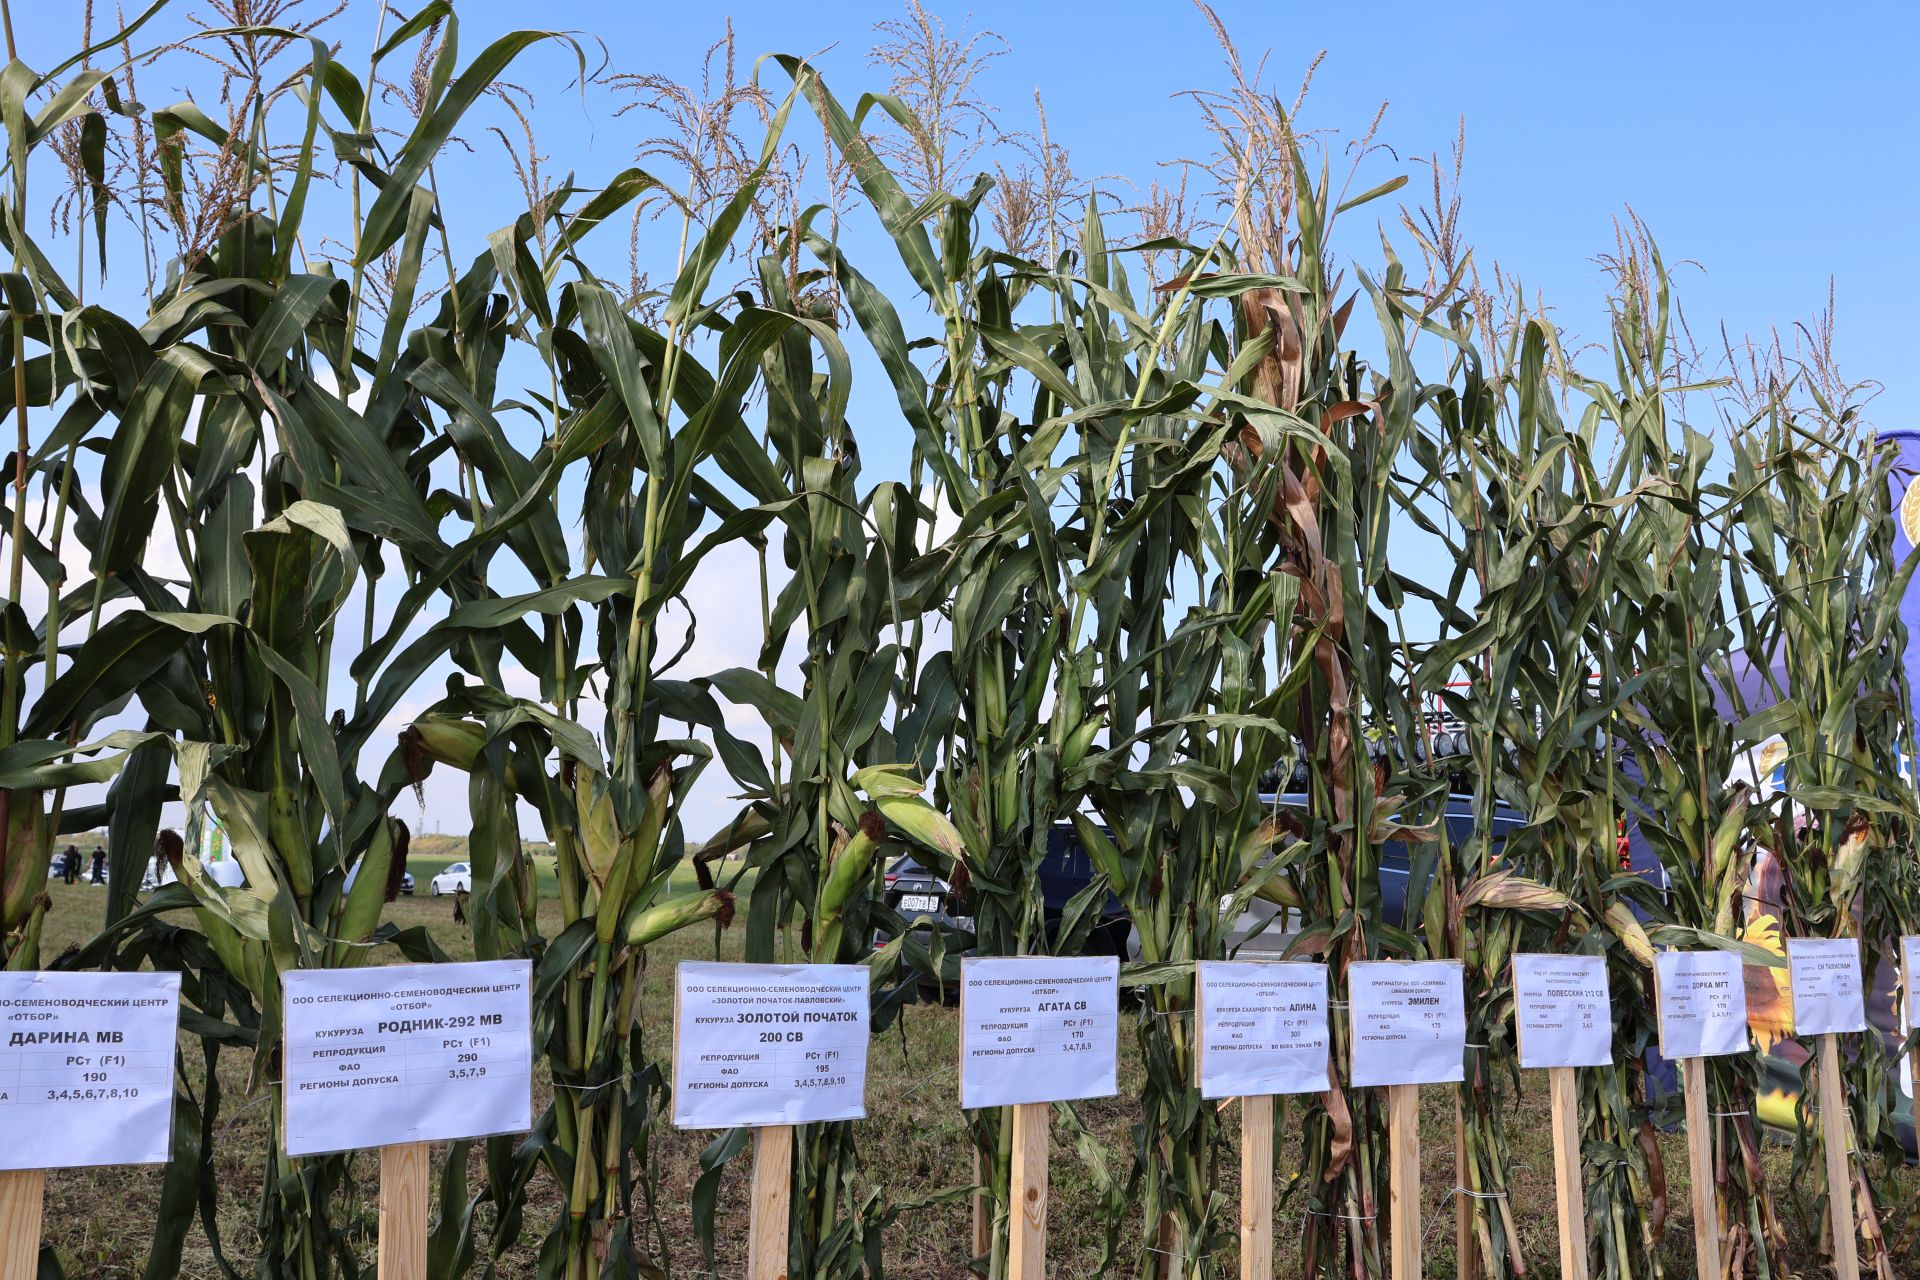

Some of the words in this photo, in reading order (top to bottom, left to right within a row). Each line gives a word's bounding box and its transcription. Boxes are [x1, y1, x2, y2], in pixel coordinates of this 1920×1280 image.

[292, 996, 314, 1004] ООО
[318, 984, 490, 1003] СЕЛЕКЦИОННО-СЕМЕНОВОДЧЕСКИЙ
[492, 984, 520, 993] ЦЕНТР
[706, 984, 842, 994] СЕЛЕКЦИОННО-СЕМЕНОВОДЧЕСКИЙ
[0, 998, 129, 1008] О-СЕМЕНОВОДЧЕСКИЙ
[133, 999, 168, 1008] ЦЕНТР
[390, 1002, 432, 1011] «ОТБОР»
[1038, 1002, 1071, 1012] АГАТА
[1074, 1002, 1086, 1010] СВ
[1408, 998, 1440, 1006] ЭМИЛЕН
[1290, 1003, 1316, 1012] АЛИНА
[8, 1013, 59, 1021] «ОТБОР»
[737, 1011, 800, 1024] ЗОЛОТОЙ
[804, 1011, 858, 1022] ПОЧАТОК
[315, 1028, 364, 1038] КУКУРУЗА
[378, 1016, 475, 1034] РОДНИК-292
[480, 1014, 502, 1026] МВ
[980, 1022, 1028, 1030] РЕПРОДУКЦИЯ
[9, 1031, 90, 1046] ДАРИНА
[96, 1031, 124, 1043] МВ
[760, 1032, 782, 1042] 200
[786, 1032, 804, 1042] СВ
[312, 1046, 386, 1058] РЕПРОДУКЦИЯ
[470, 1038, 490, 1048] (F1)
[1006, 1048, 1036, 1056] ДОПУСКА
[100, 1055, 125, 1067] (F1)
[700, 1054, 760, 1062] РЕПРОДУКЦИЯ
[825, 1051, 839, 1060] (F1)
[338, 1064, 360, 1072] ФАО
[458, 1054, 478, 1063] 290
[82, 1072, 107, 1082] 190
[300, 1080, 350, 1090] РЕГИОНЫ
[352, 1076, 398, 1087] ДОПУСКА
[449, 1068, 486, 1080] 3,5,7,9
[730, 1081, 768, 1089] ДОПУСКА
[794, 1077, 846, 1088] 3,4,5,7,8,9,10
[47, 1088, 138, 1100] 3,4,5,6,7,8,10
